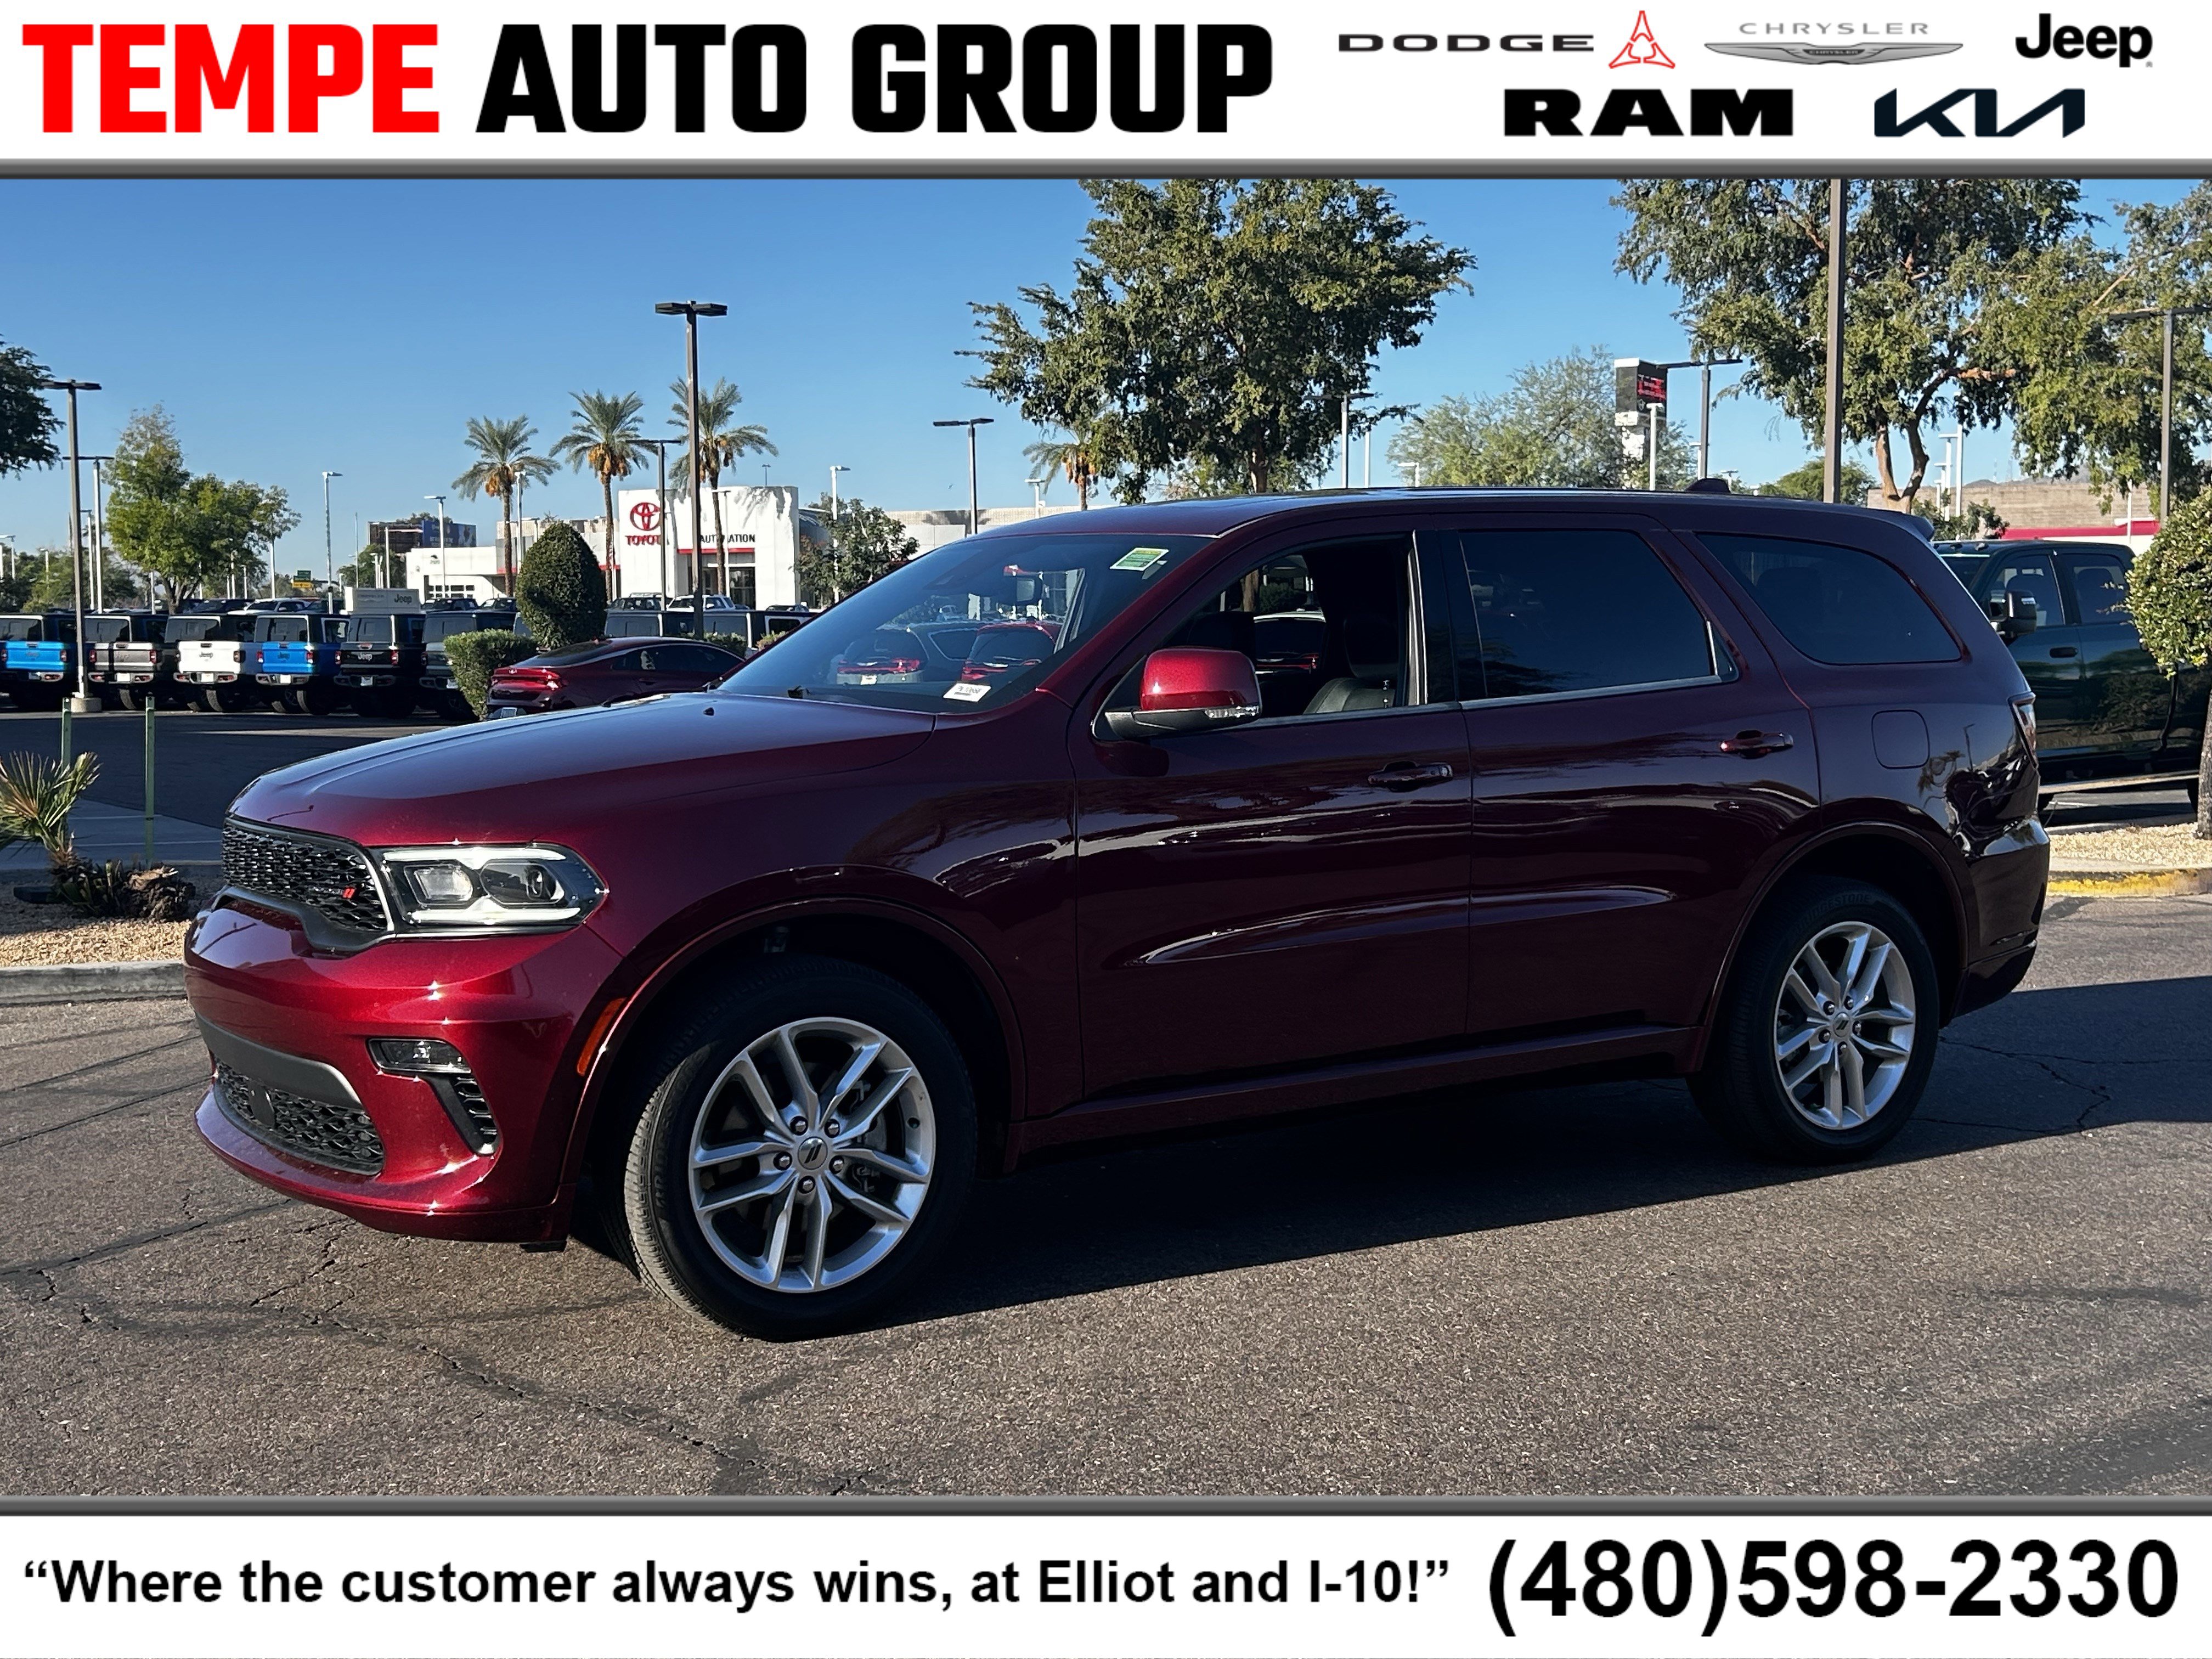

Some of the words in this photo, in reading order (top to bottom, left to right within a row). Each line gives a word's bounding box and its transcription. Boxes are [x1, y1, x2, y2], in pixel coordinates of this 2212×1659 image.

[625, 535, 670, 546] TOYOT
[700, 534, 755, 543] AUTATION
[394, 594, 412, 604] Jeep
[358, 652, 373, 661] Jeep
